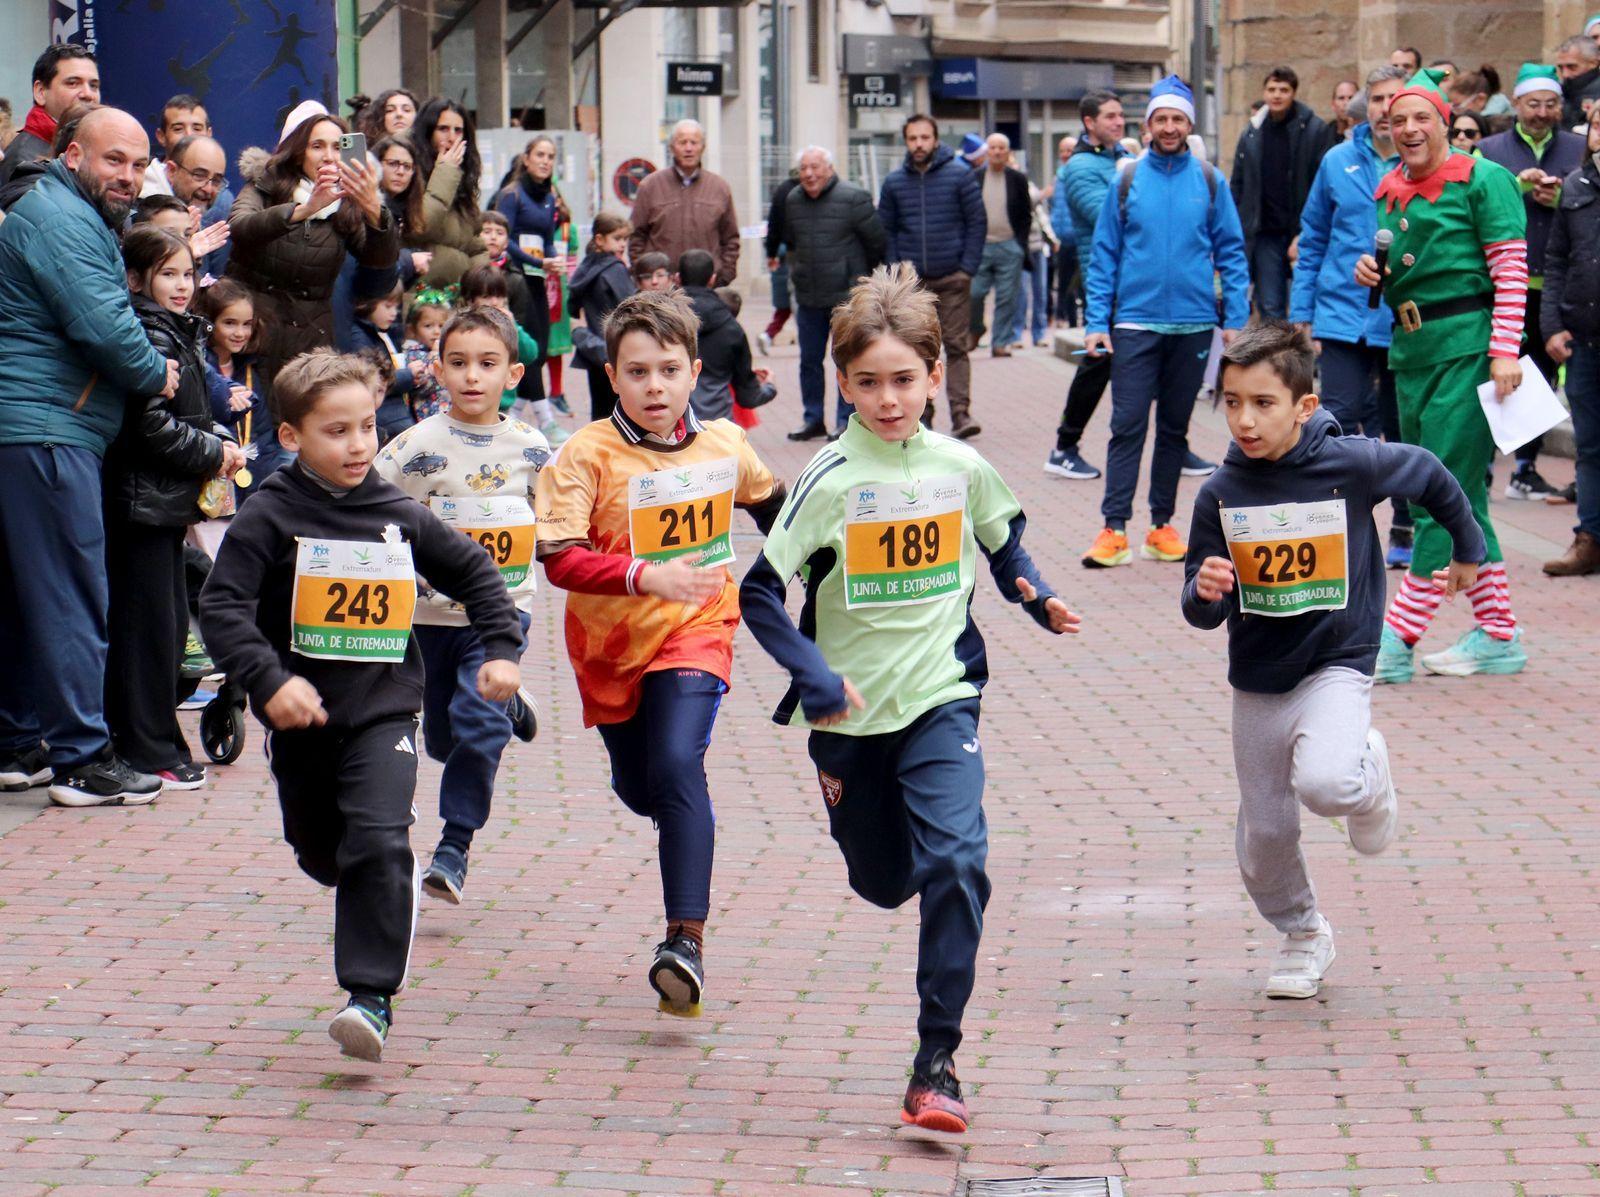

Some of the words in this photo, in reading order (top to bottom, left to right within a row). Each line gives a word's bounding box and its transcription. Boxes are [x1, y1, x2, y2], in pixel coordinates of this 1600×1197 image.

[53, 0, 79, 48] R
[659, 500, 713, 547] 211
[890, 503, 929, 514] Extremadura
[466, 531, 513, 565] 69
[879, 521, 940, 568] 189
[342, 565, 382, 573] Extremadura
[1253, 542, 1317, 583] 229
[852, 582, 882, 598] JUNTA
[887, 581, 899, 594] DE
[903, 571, 957, 593] EXTREMADURA
[1245, 591, 1265, 605] JUNTA
[1266, 595, 1276, 606] DE
[1280, 587, 1341, 606] EXTREMADURA
[324, 582, 390, 625] 243
[298, 632, 325, 648] JUNTA
[330, 635, 342, 648] DE
